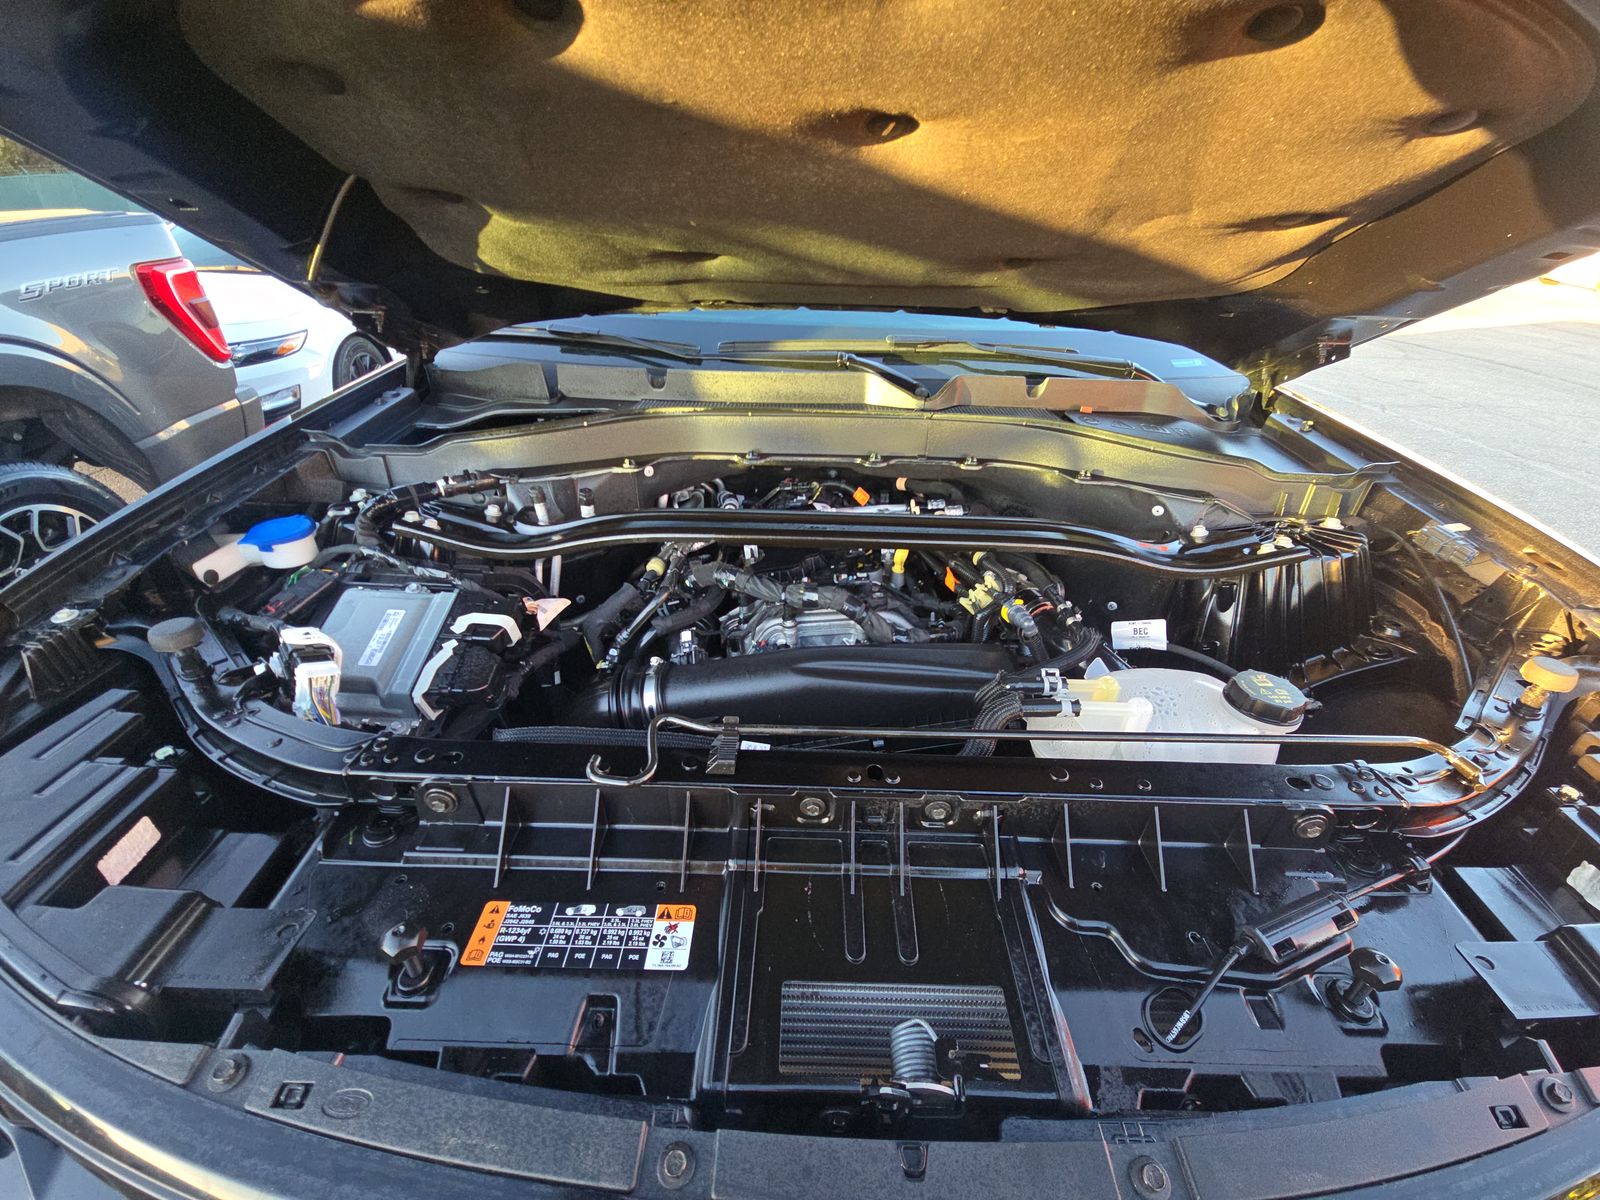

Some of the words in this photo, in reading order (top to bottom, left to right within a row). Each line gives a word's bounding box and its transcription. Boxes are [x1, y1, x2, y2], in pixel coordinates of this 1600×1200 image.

[18, 267, 118, 303] SPORT
[1133, 627, 1149, 636] BEC
[507, 905, 542, 914] FoMoCo
[499, 927, 532, 935] R-1234yf
[495, 935, 517, 943] (GWP
